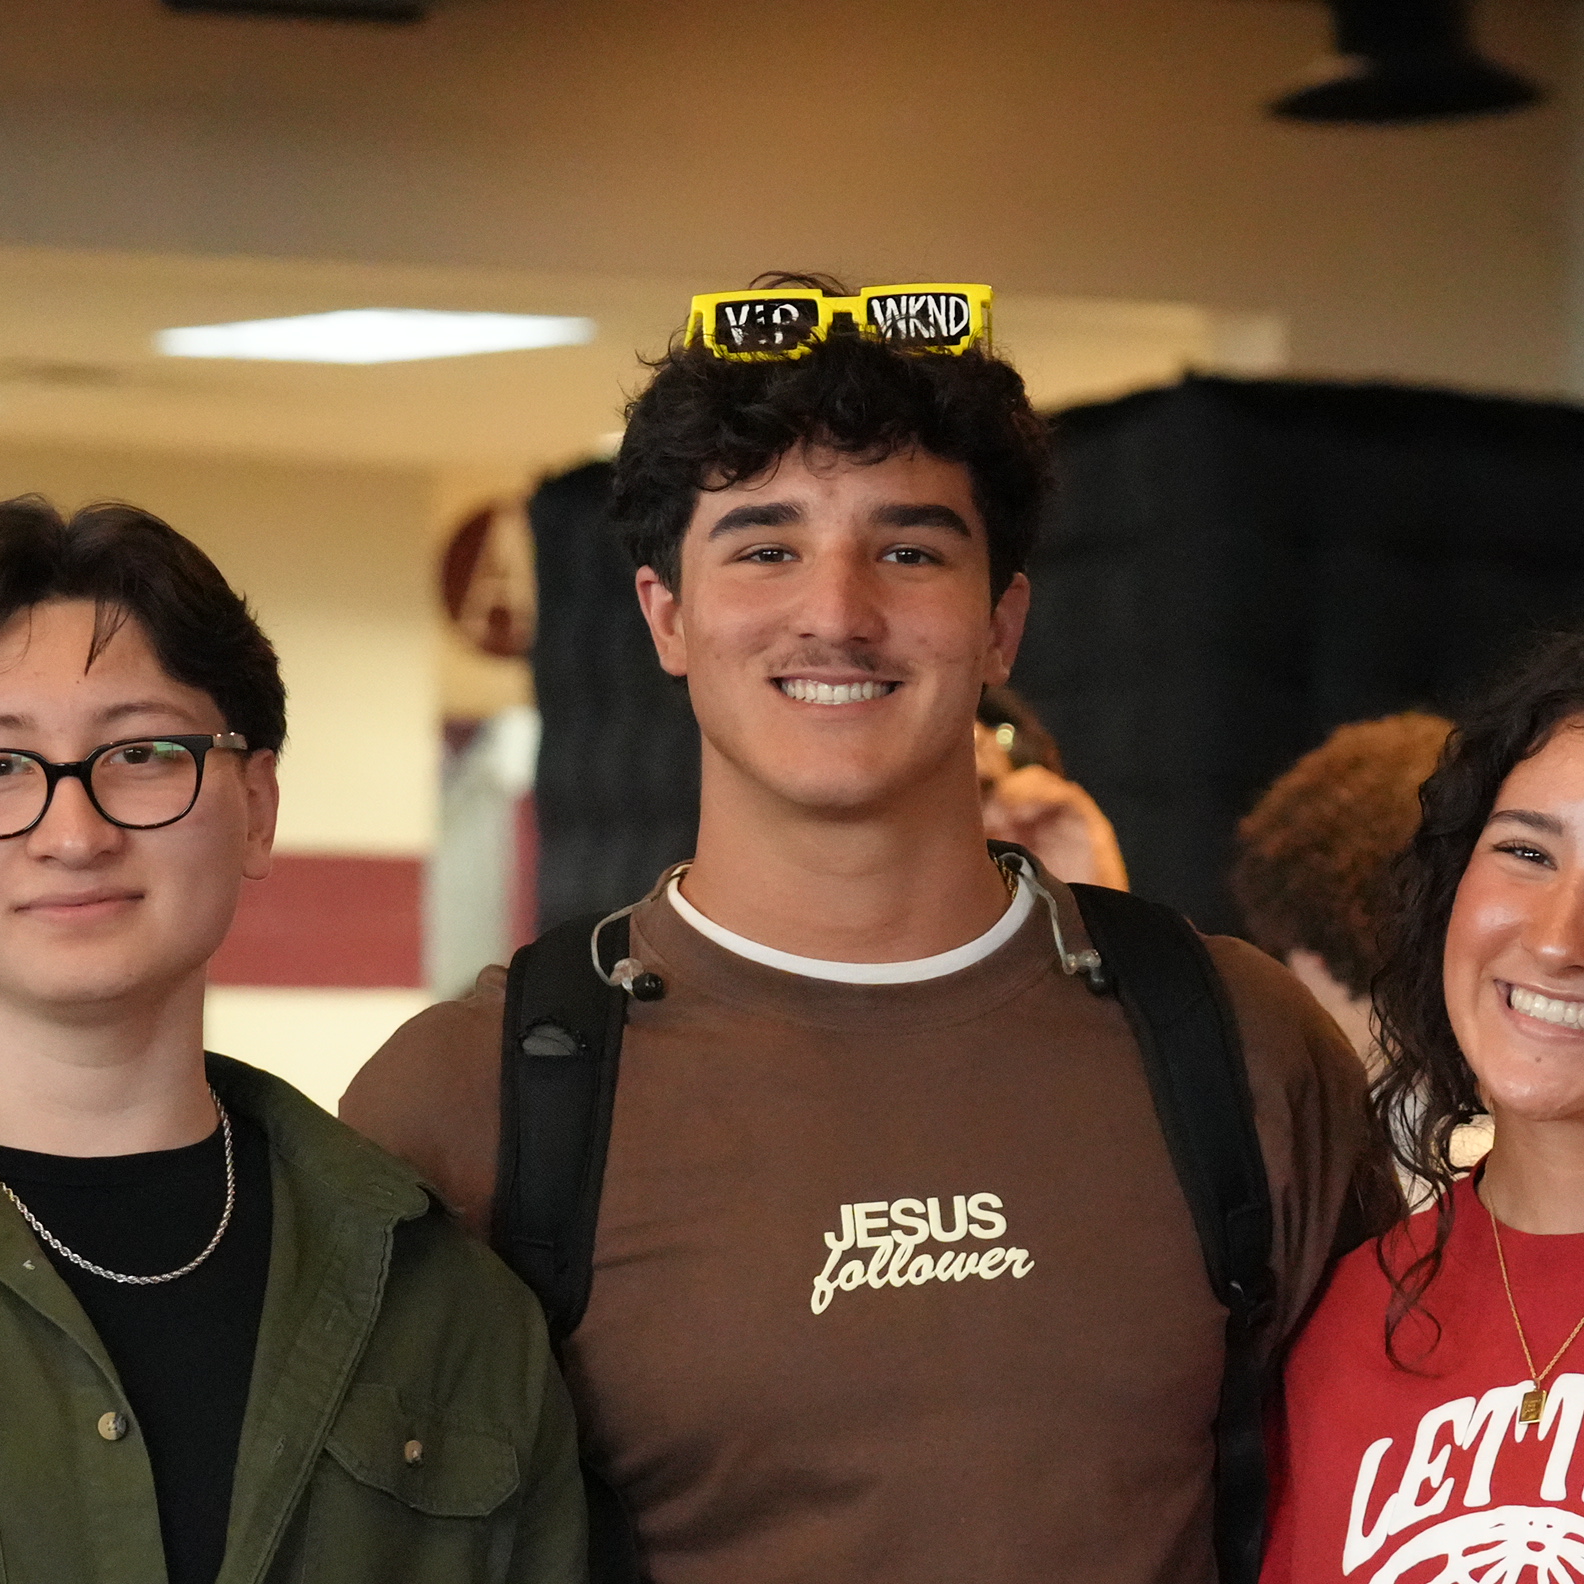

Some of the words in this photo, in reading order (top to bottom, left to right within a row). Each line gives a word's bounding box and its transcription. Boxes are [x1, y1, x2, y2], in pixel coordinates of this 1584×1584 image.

[871, 294, 970, 340] WKND
[824, 1192, 1007, 1251] JESUS
[811, 1240, 1035, 1315] follower
[1342, 1380, 1537, 1577] LET
